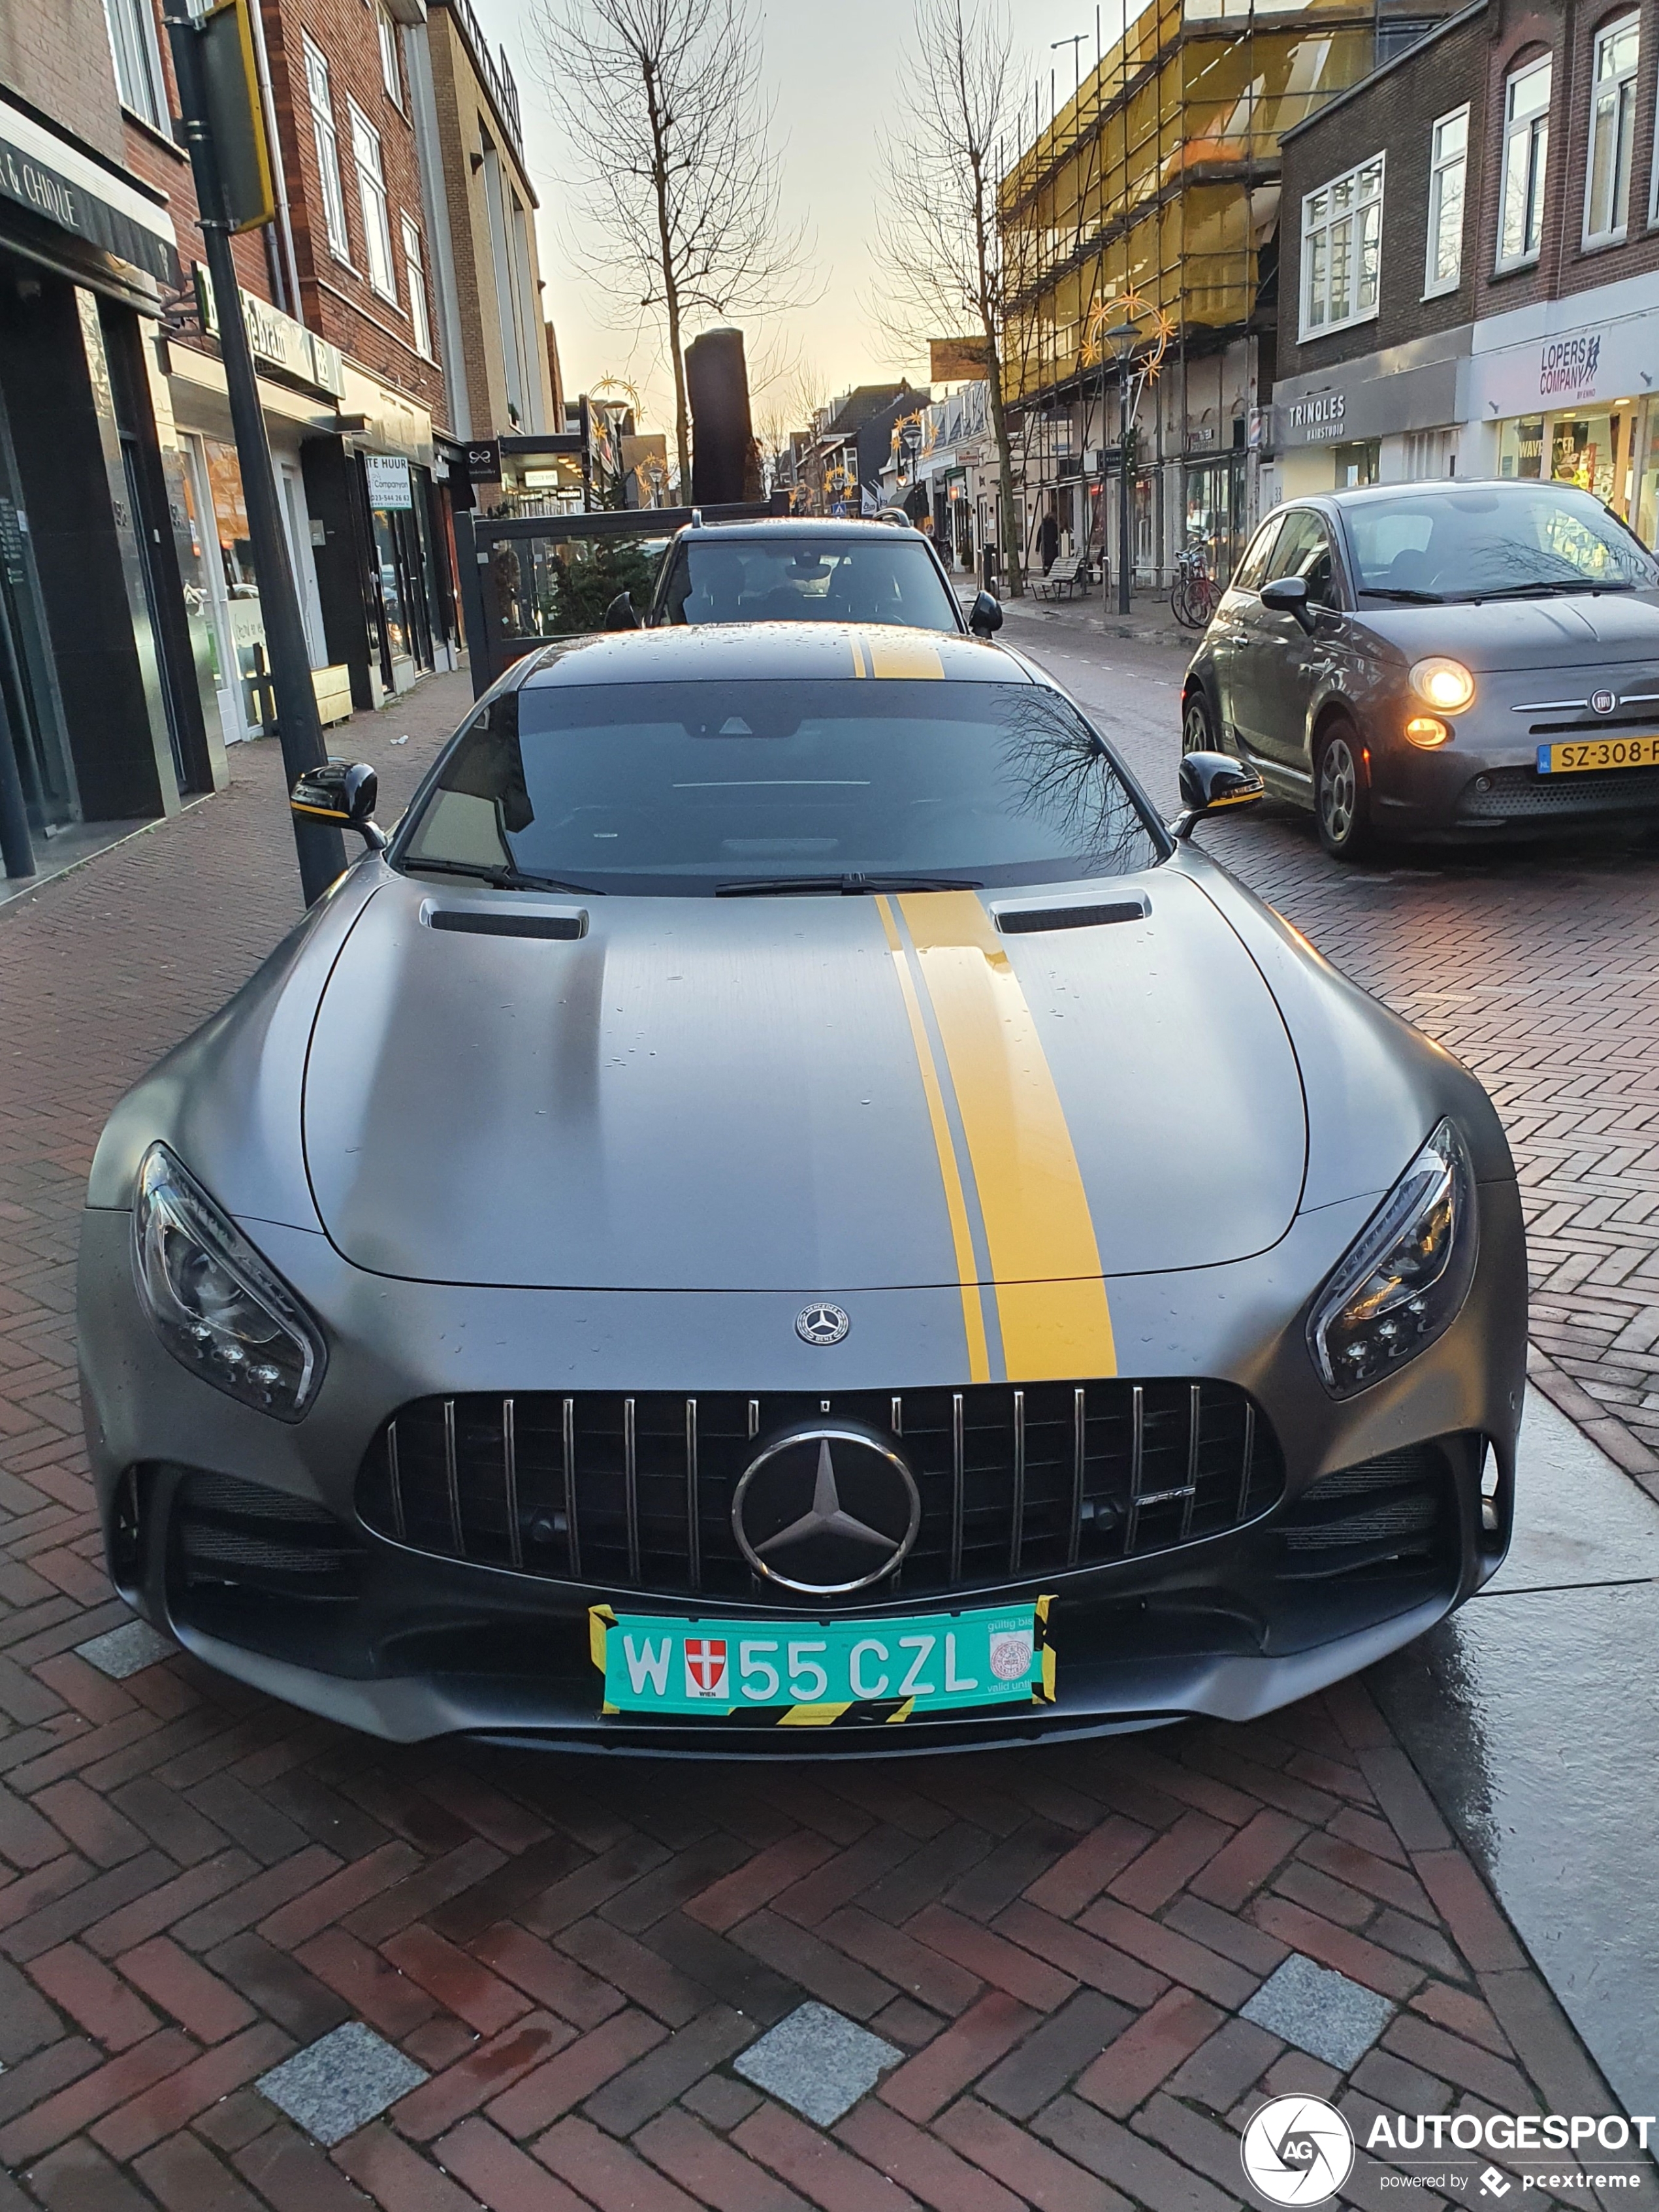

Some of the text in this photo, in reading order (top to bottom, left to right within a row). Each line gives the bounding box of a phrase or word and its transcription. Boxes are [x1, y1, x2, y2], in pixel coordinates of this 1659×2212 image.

[24, 164, 80, 227] CHIQUE
[1541, 338, 1586, 371] LOPERS
[1540, 365, 1585, 395] COMPANY
[1306, 423, 1344, 441] HAIRSTUDIO
[367, 458, 407, 469] TE HUUR
[1597, 696, 1611, 708] FIAT
[988, 1617, 1033, 1633] gültig bis
[624, 1632, 979, 1701] W 55 CZL
[987, 1681, 1010, 1693] valid
